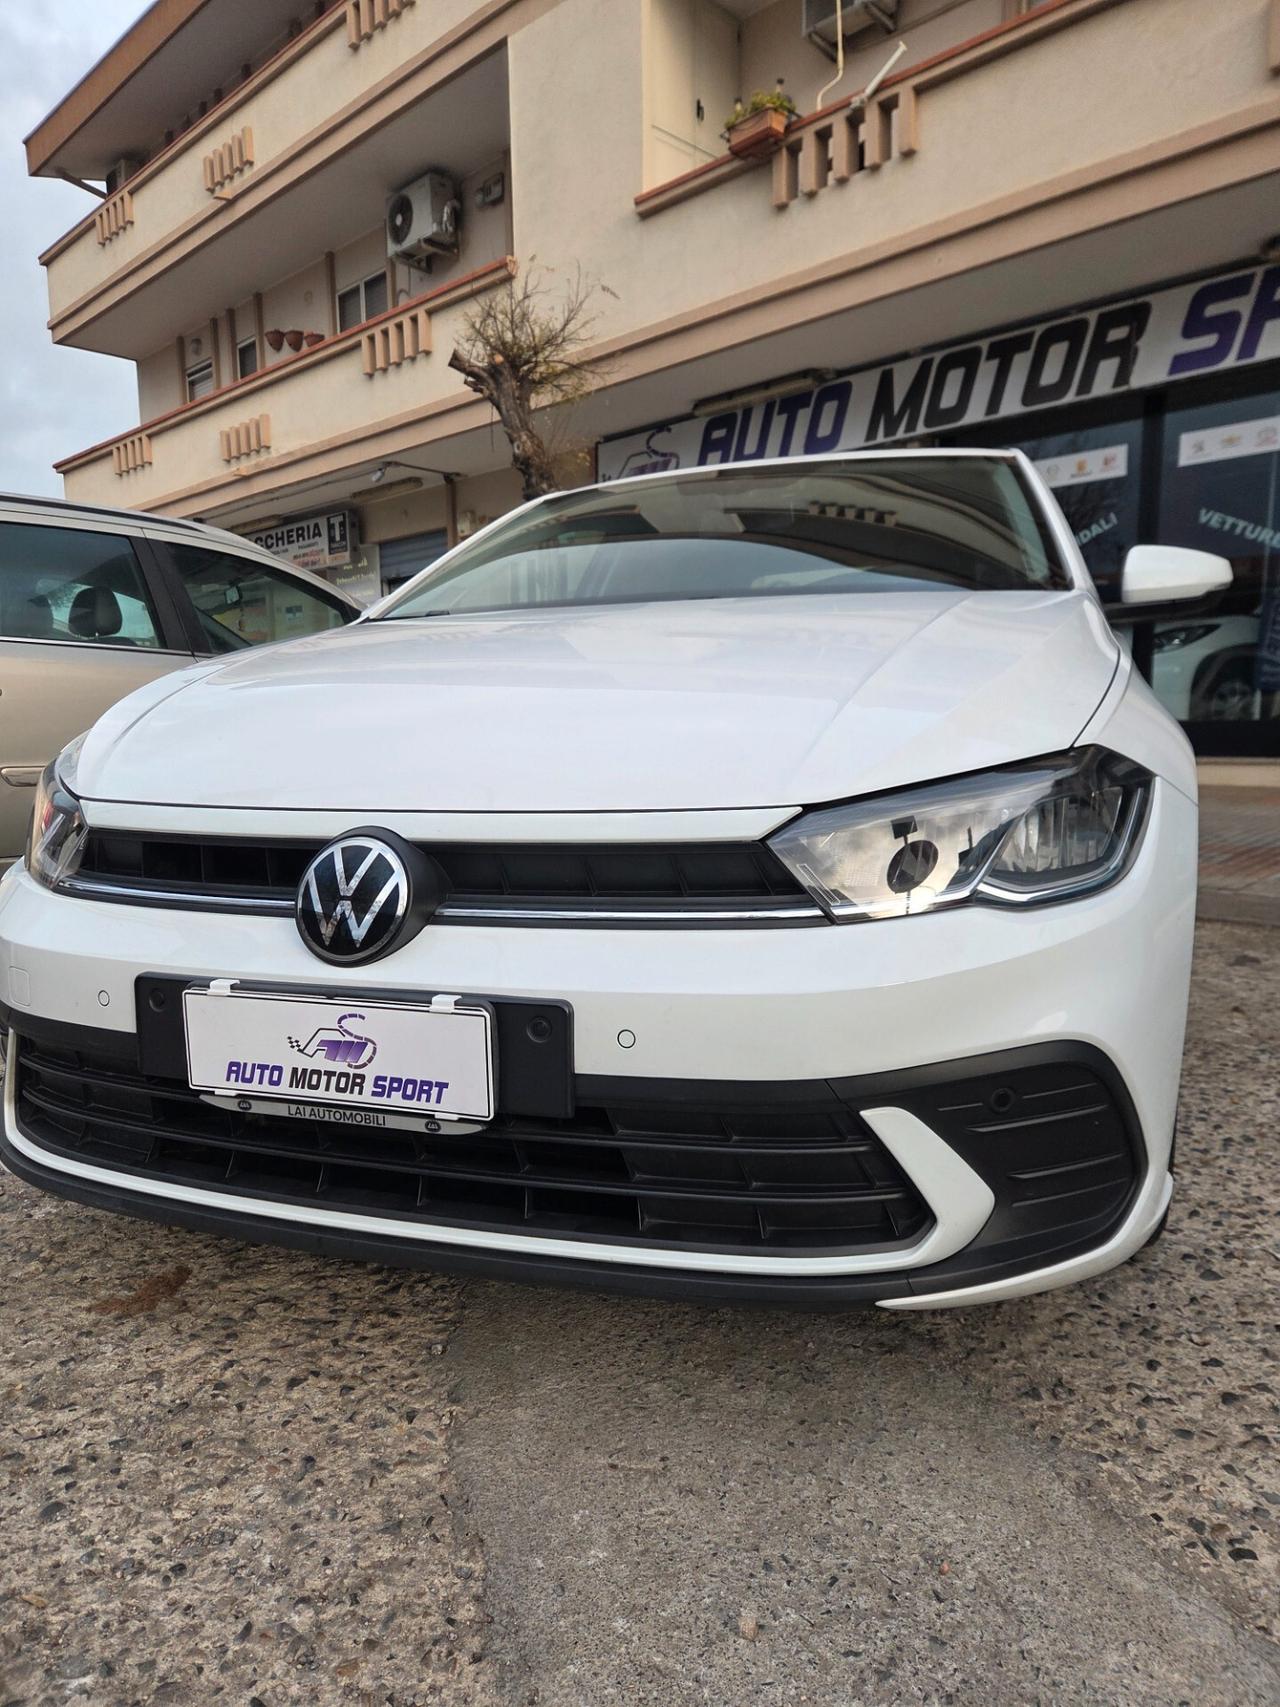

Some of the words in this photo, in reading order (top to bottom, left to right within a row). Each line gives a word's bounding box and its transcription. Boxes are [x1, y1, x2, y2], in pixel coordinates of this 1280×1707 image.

[698, 380, 853, 467] AUTO
[864, 300, 1153, 443] MOTOR
[1075, 511, 1119, 546] DALI
[225, 1061, 284, 1087] AUTO
[288, 1066, 366, 1096] MOTOR
[371, 1075, 449, 1104] SPORT
[287, 1105, 305, 1117] LAI
[309, 1107, 386, 1127] AUTOMOBILI
